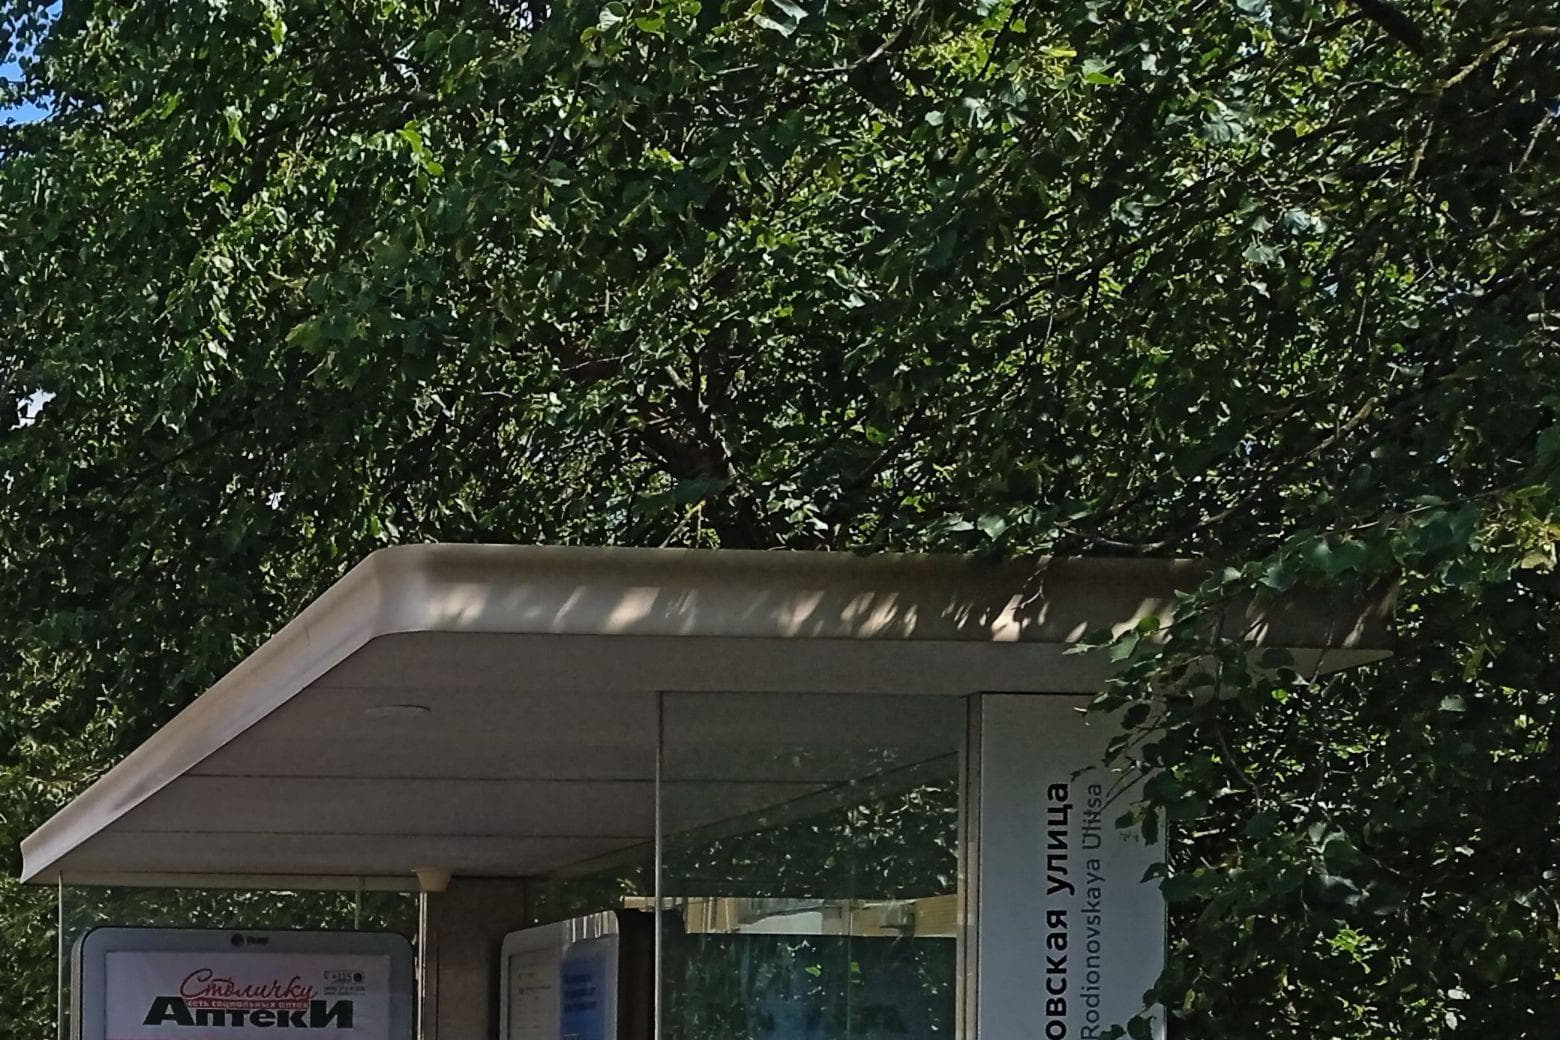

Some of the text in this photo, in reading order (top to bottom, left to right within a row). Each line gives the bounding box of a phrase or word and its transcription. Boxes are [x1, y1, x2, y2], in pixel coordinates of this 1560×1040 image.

[1046, 783, 1075, 896] улица
[1080, 784, 1105, 1040] Rodionovskaya Ulitsa
